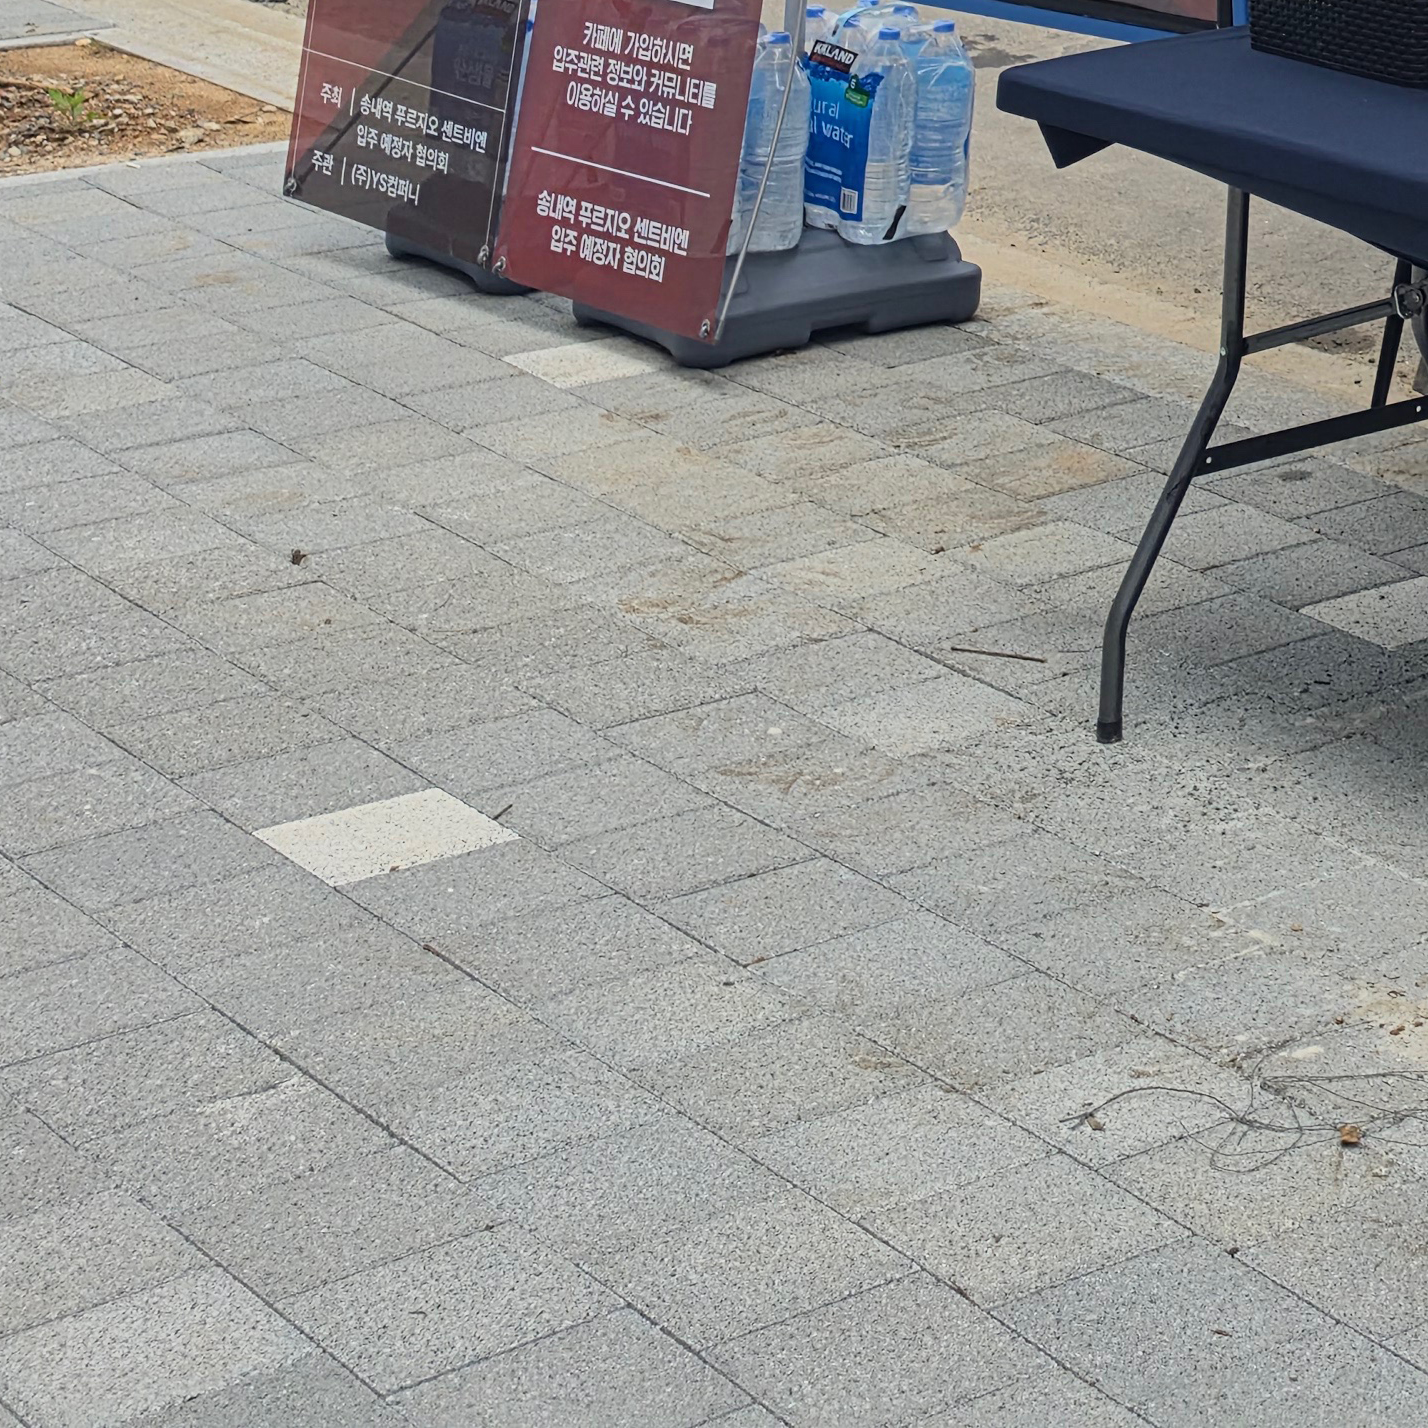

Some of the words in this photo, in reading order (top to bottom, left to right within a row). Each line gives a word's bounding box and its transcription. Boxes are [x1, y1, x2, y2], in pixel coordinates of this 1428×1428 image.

[583, 22, 623, 54] 카페에
[625, 32, 693, 70] 가입하시면
[553, 46, 604, 81] 입주관련
[607, 59, 647, 91] 정보와
[649, 69, 716, 114] 커뮤니티를
[567, 81, 618, 117] 이용하실
[621, 95, 635, 120] 수
[638, 98, 692, 135] 있습니다
[321, 83, 342, 108] 주최
[361, 94, 393, 123] 송내역
[395, 105, 438, 135] 푸르지오
[441, 121, 487, 153] 센트비엔
[312, 150, 333, 175] 주관
[352, 164, 420, 205] (주)YS컴퍼니
[357, 125, 378, 149] 입주
[380, 133, 413, 162] 예정자
[416, 144, 448, 174] 협의회
[537, 190, 576, 224] 송내역
[579, 201, 631, 238] 푸르지오
[634, 217, 689, 256] 센트비엔
[551, 225, 577, 255] 입주
[580, 234, 620, 269] 예정자
[623, 246, 665, 282] 협의회
